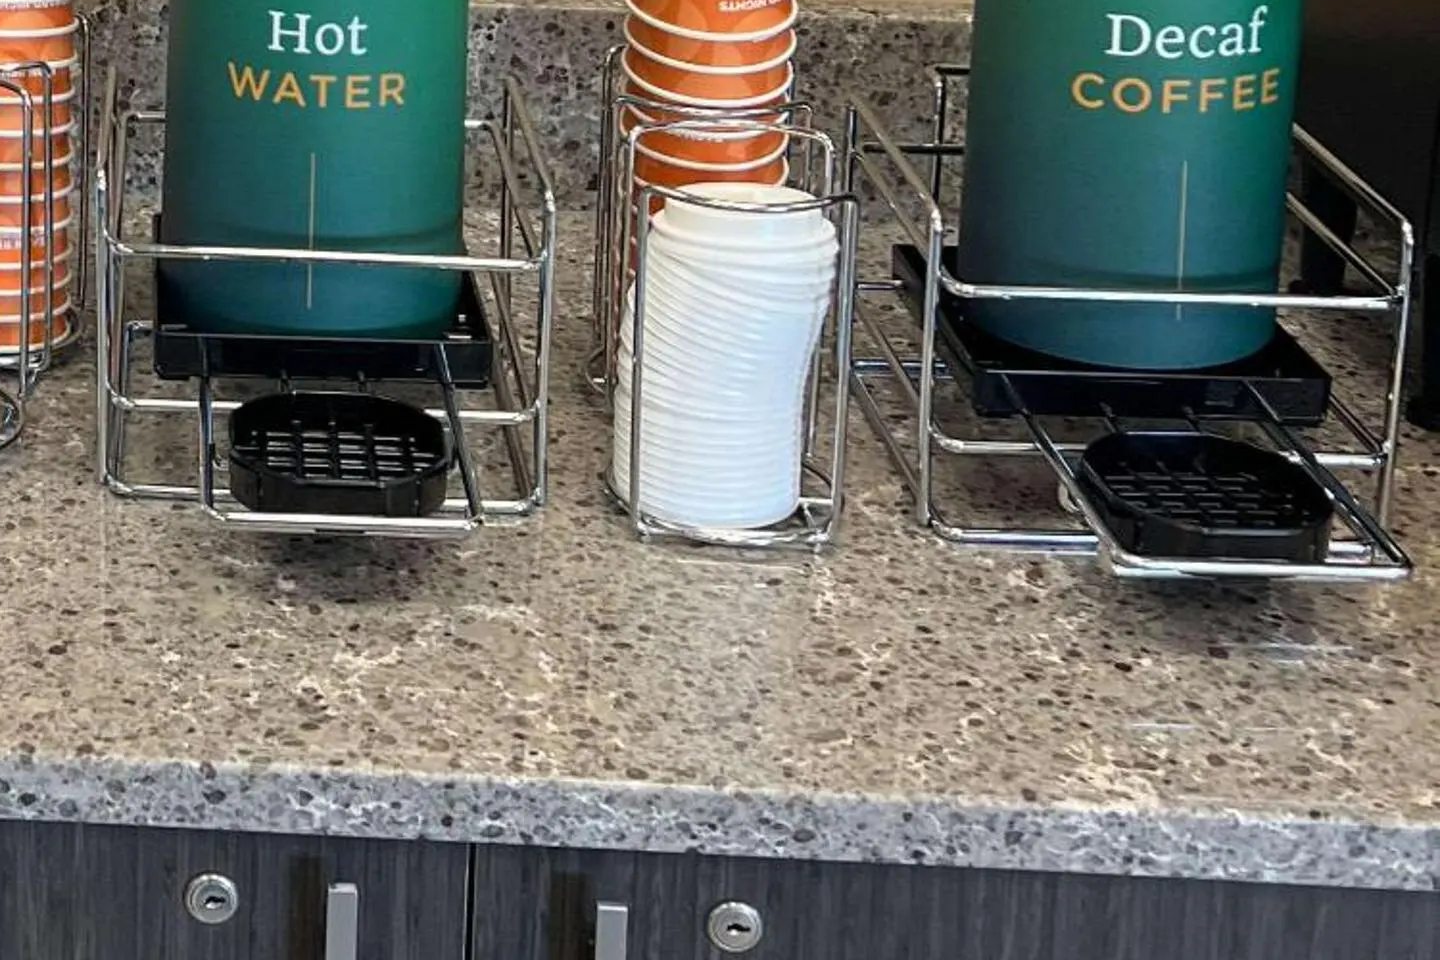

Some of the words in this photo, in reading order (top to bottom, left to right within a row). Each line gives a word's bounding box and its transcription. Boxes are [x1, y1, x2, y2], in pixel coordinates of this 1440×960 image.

[268, 9, 368, 55] Hot
[1103, 5, 1269, 59] Decaf
[228, 61, 406, 108] WATER
[1072, 67, 1281, 113] COFFEE
